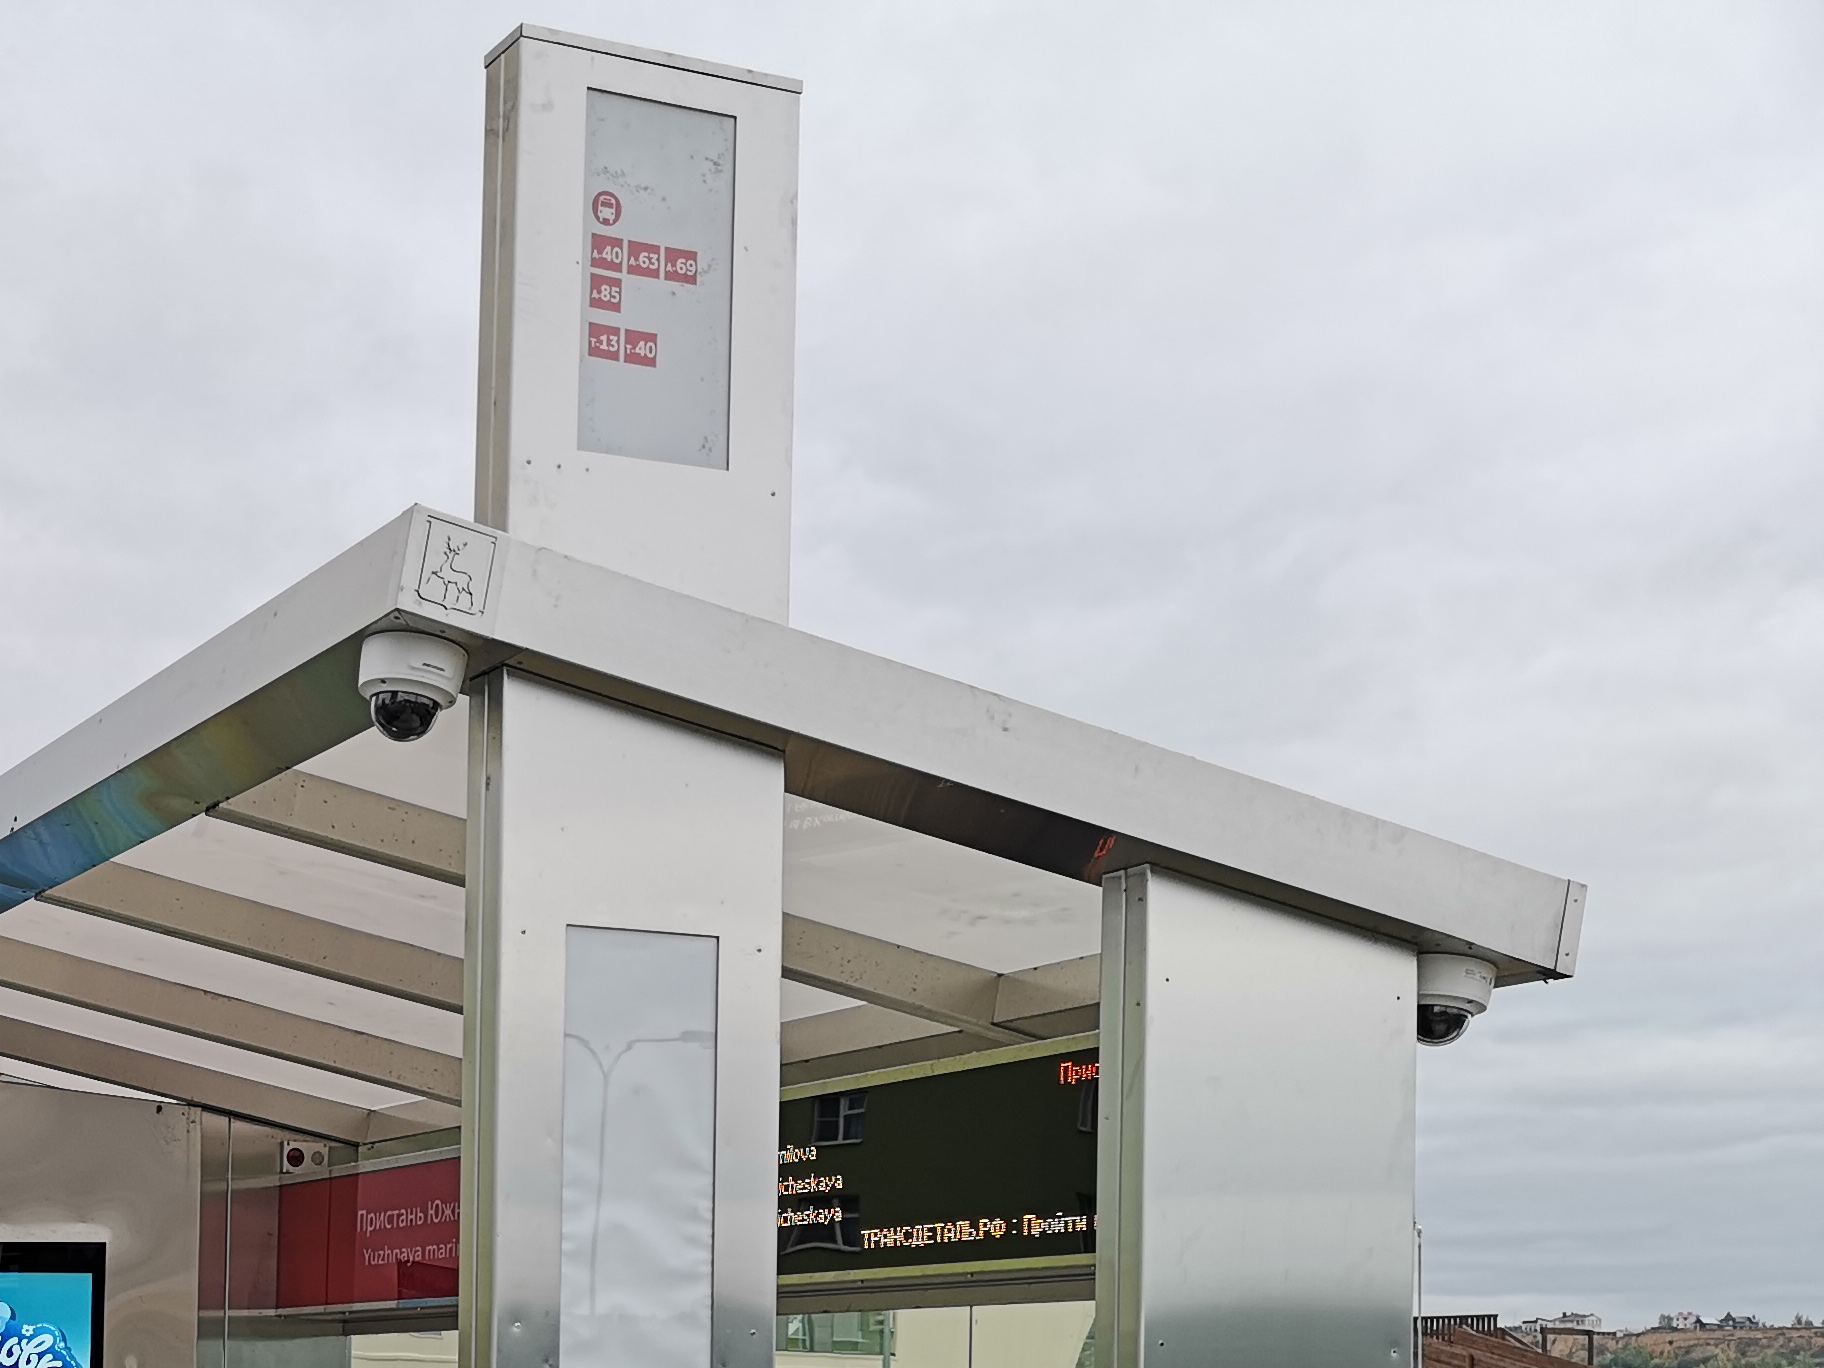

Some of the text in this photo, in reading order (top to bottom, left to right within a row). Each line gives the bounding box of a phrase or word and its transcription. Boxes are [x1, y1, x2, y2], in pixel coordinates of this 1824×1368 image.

[592, 245, 696, 276] А-40 А-63 А-69
[591, 284, 620, 303] А-85
[589, 334, 656, 358] Т-13 Т-40
[357, 1206, 425, 1238] Пристань
[363, 1238, 460, 1267] Yuzhnaya mari
